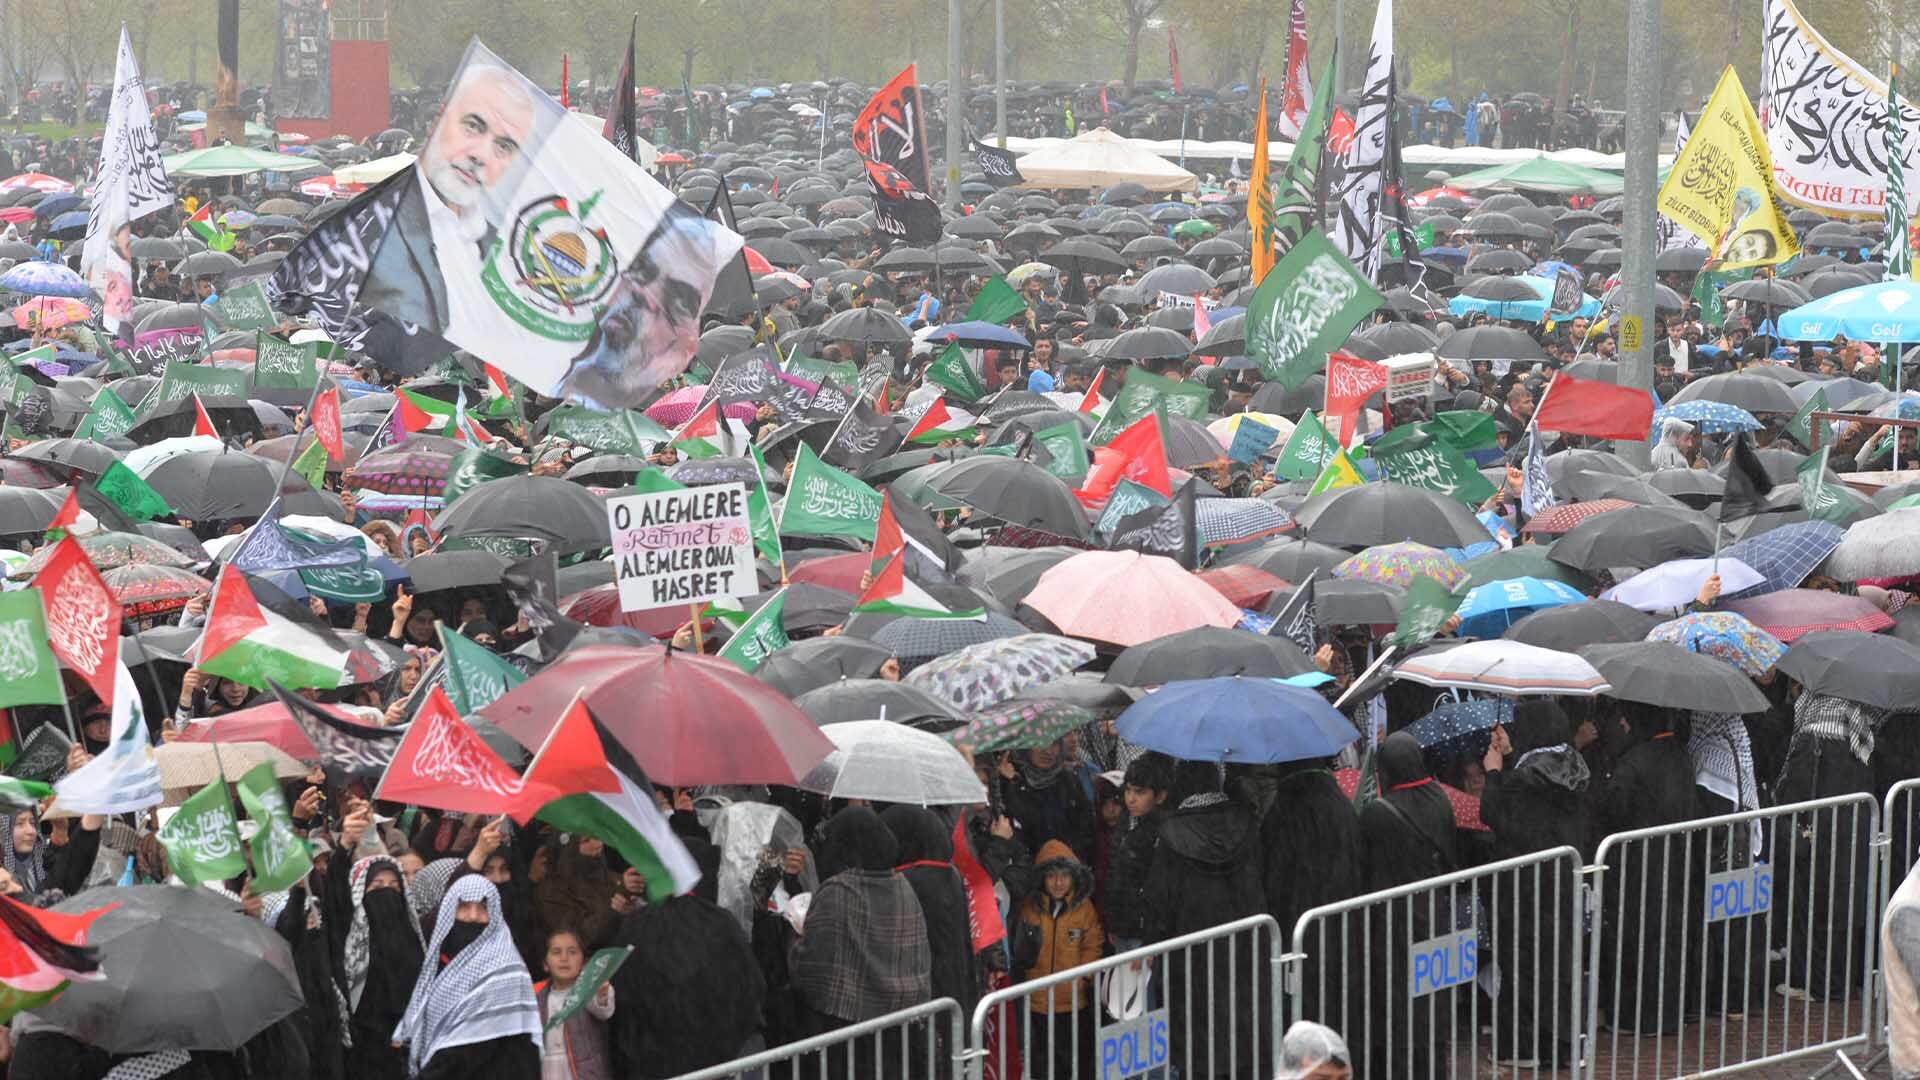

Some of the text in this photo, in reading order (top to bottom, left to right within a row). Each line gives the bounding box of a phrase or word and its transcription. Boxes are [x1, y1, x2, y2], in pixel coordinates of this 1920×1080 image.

[1871, 322, 1904, 337] Golf
[615, 489, 742, 530] O ALEMLERE
[623, 522, 725, 550] Rahmet
[620, 546, 735, 580] ALEMLER ONA
[652, 570, 735, 603] HASRET
[1711, 869, 1770, 920] POLİS
[1415, 935, 1475, 993] POLİS
[1103, 1016, 1167, 1080] POLİS
